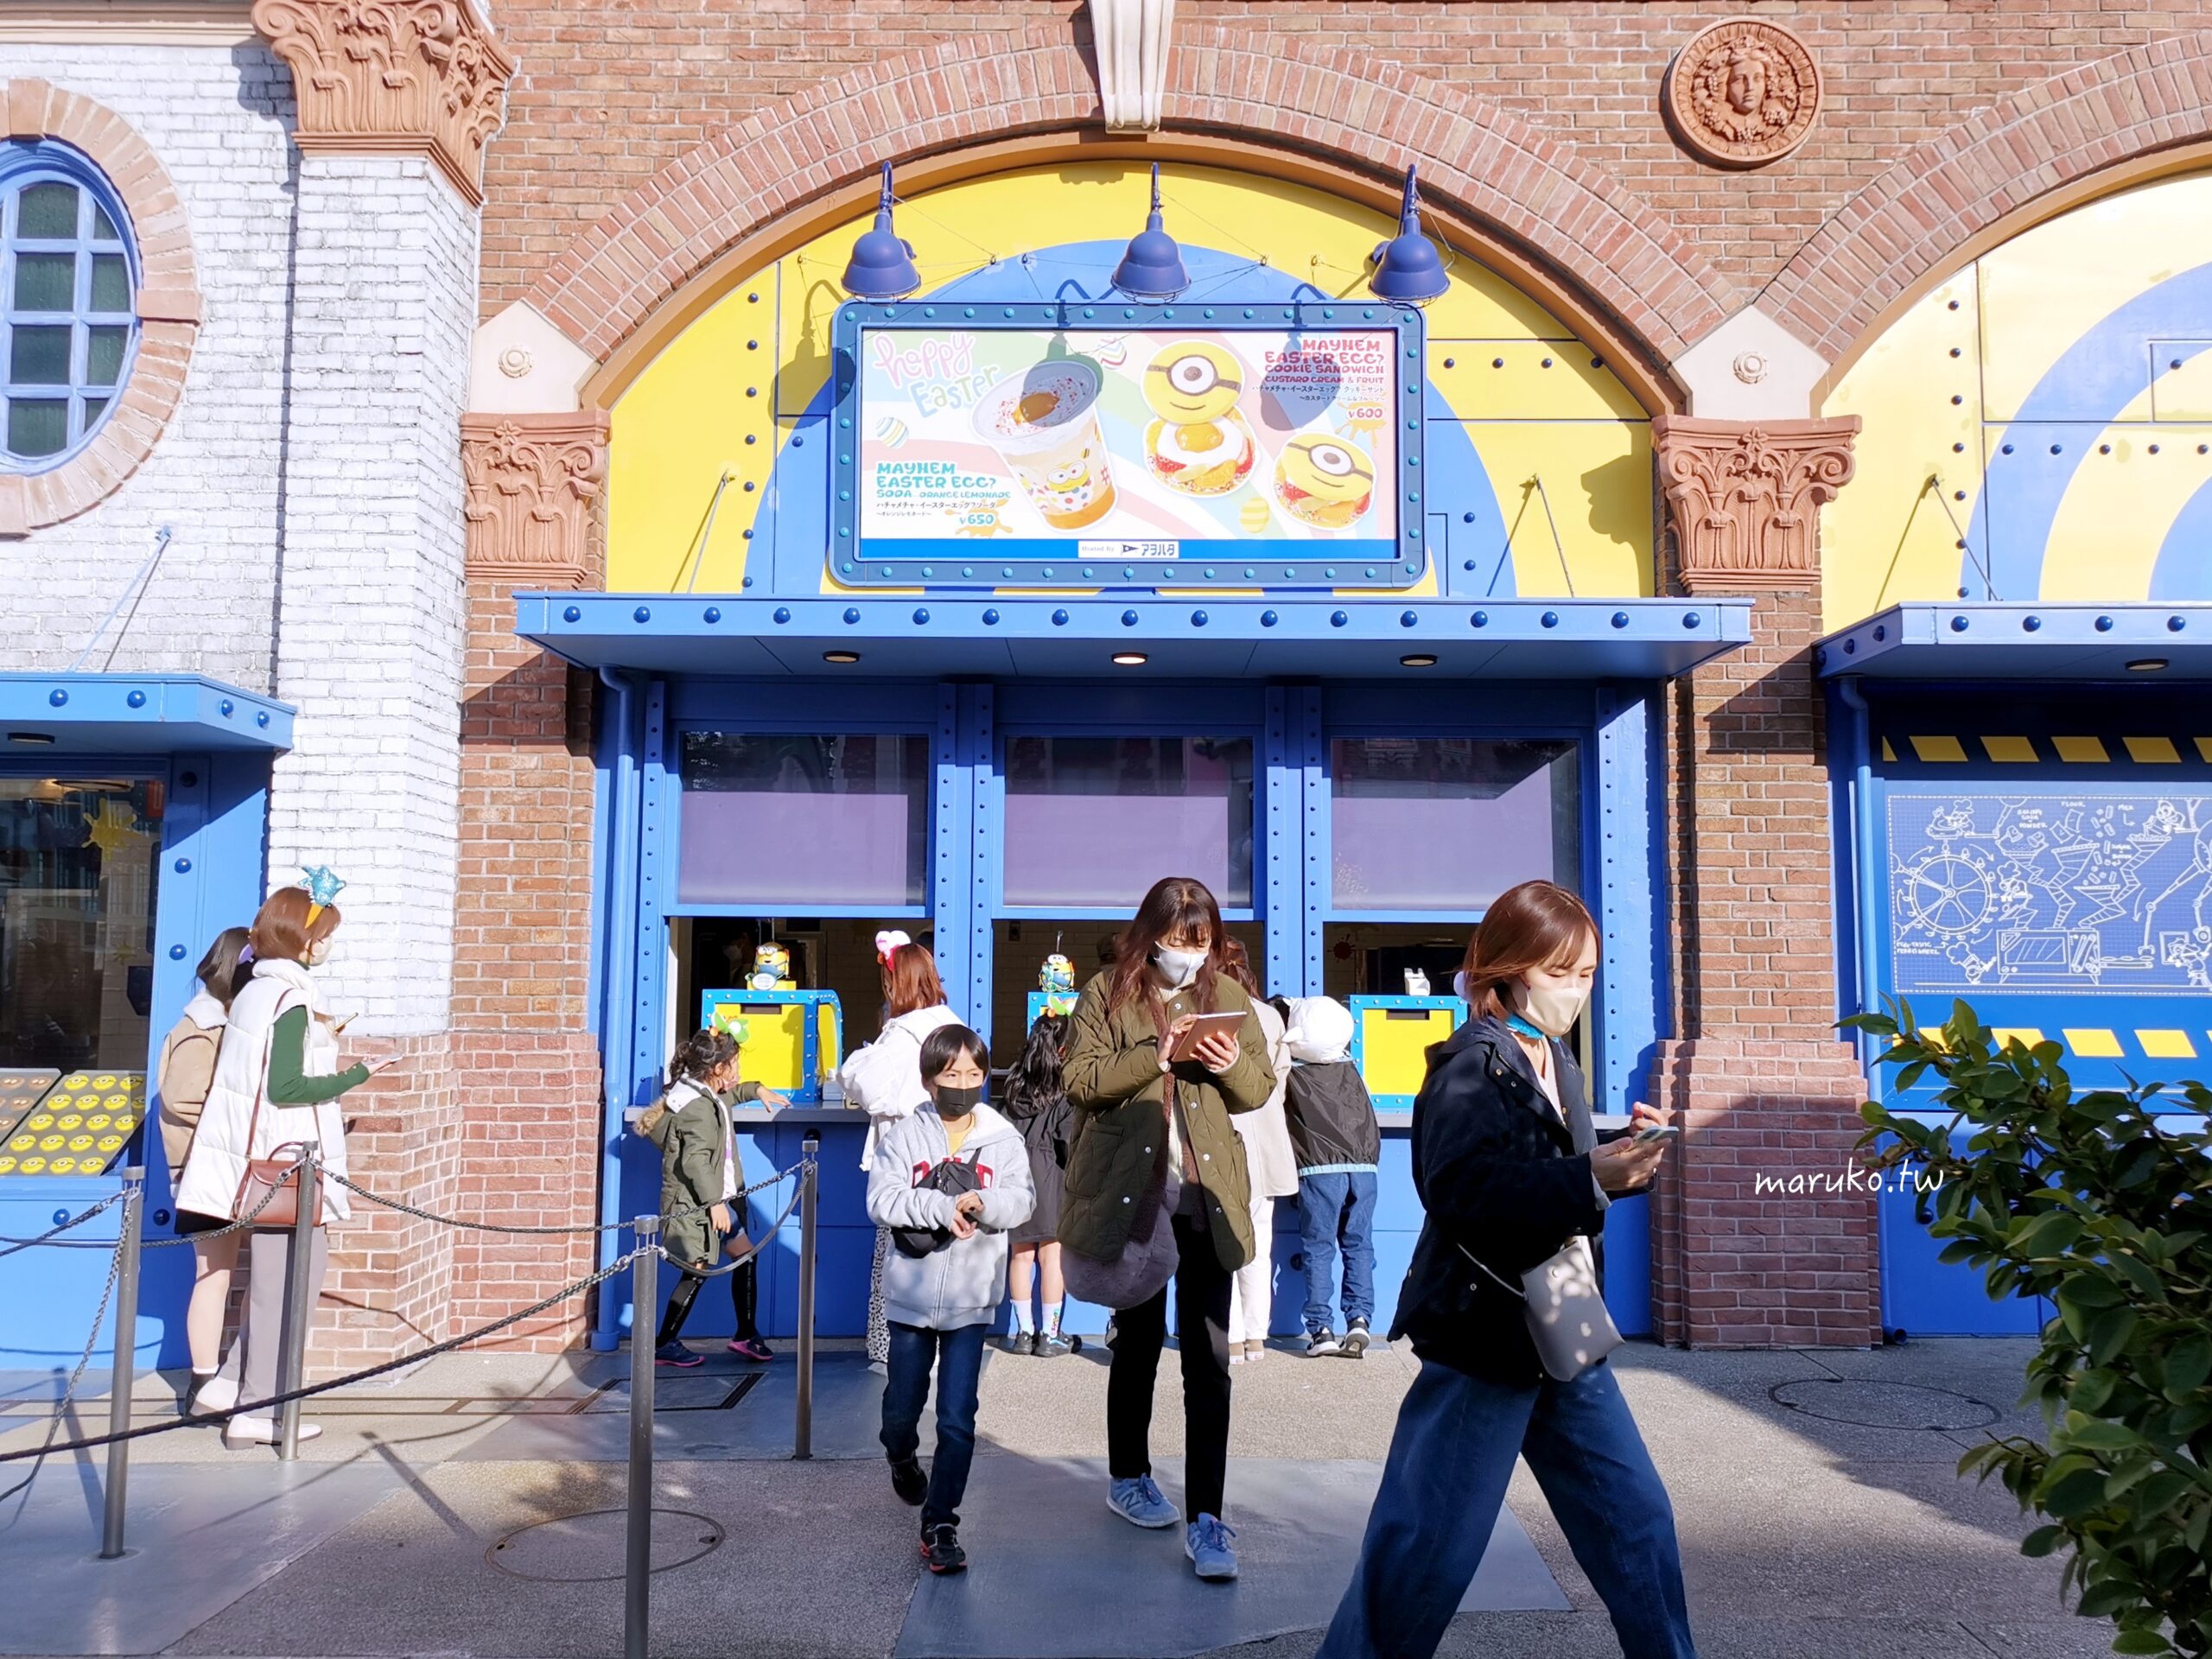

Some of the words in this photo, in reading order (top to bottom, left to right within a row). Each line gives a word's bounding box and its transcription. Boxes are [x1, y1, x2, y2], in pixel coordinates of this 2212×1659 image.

[1302, 339, 1381, 352] MAYHEM
[874, 333, 975, 387] happy
[1265, 351, 1335, 364] EASTER
[1340, 353, 1384, 365] EGG?
[1265, 365, 1312, 373] COOKIE
[1315, 365, 1384, 374] SANDWICH
[1349, 408, 1383, 418] ¥600
[877, 462, 956, 474] MAYHEM
[876, 476, 947, 488] EASTER
[951, 477, 996, 489] EGG?
[876, 489, 912, 498] SODA
[959, 514, 995, 524] ¥650
